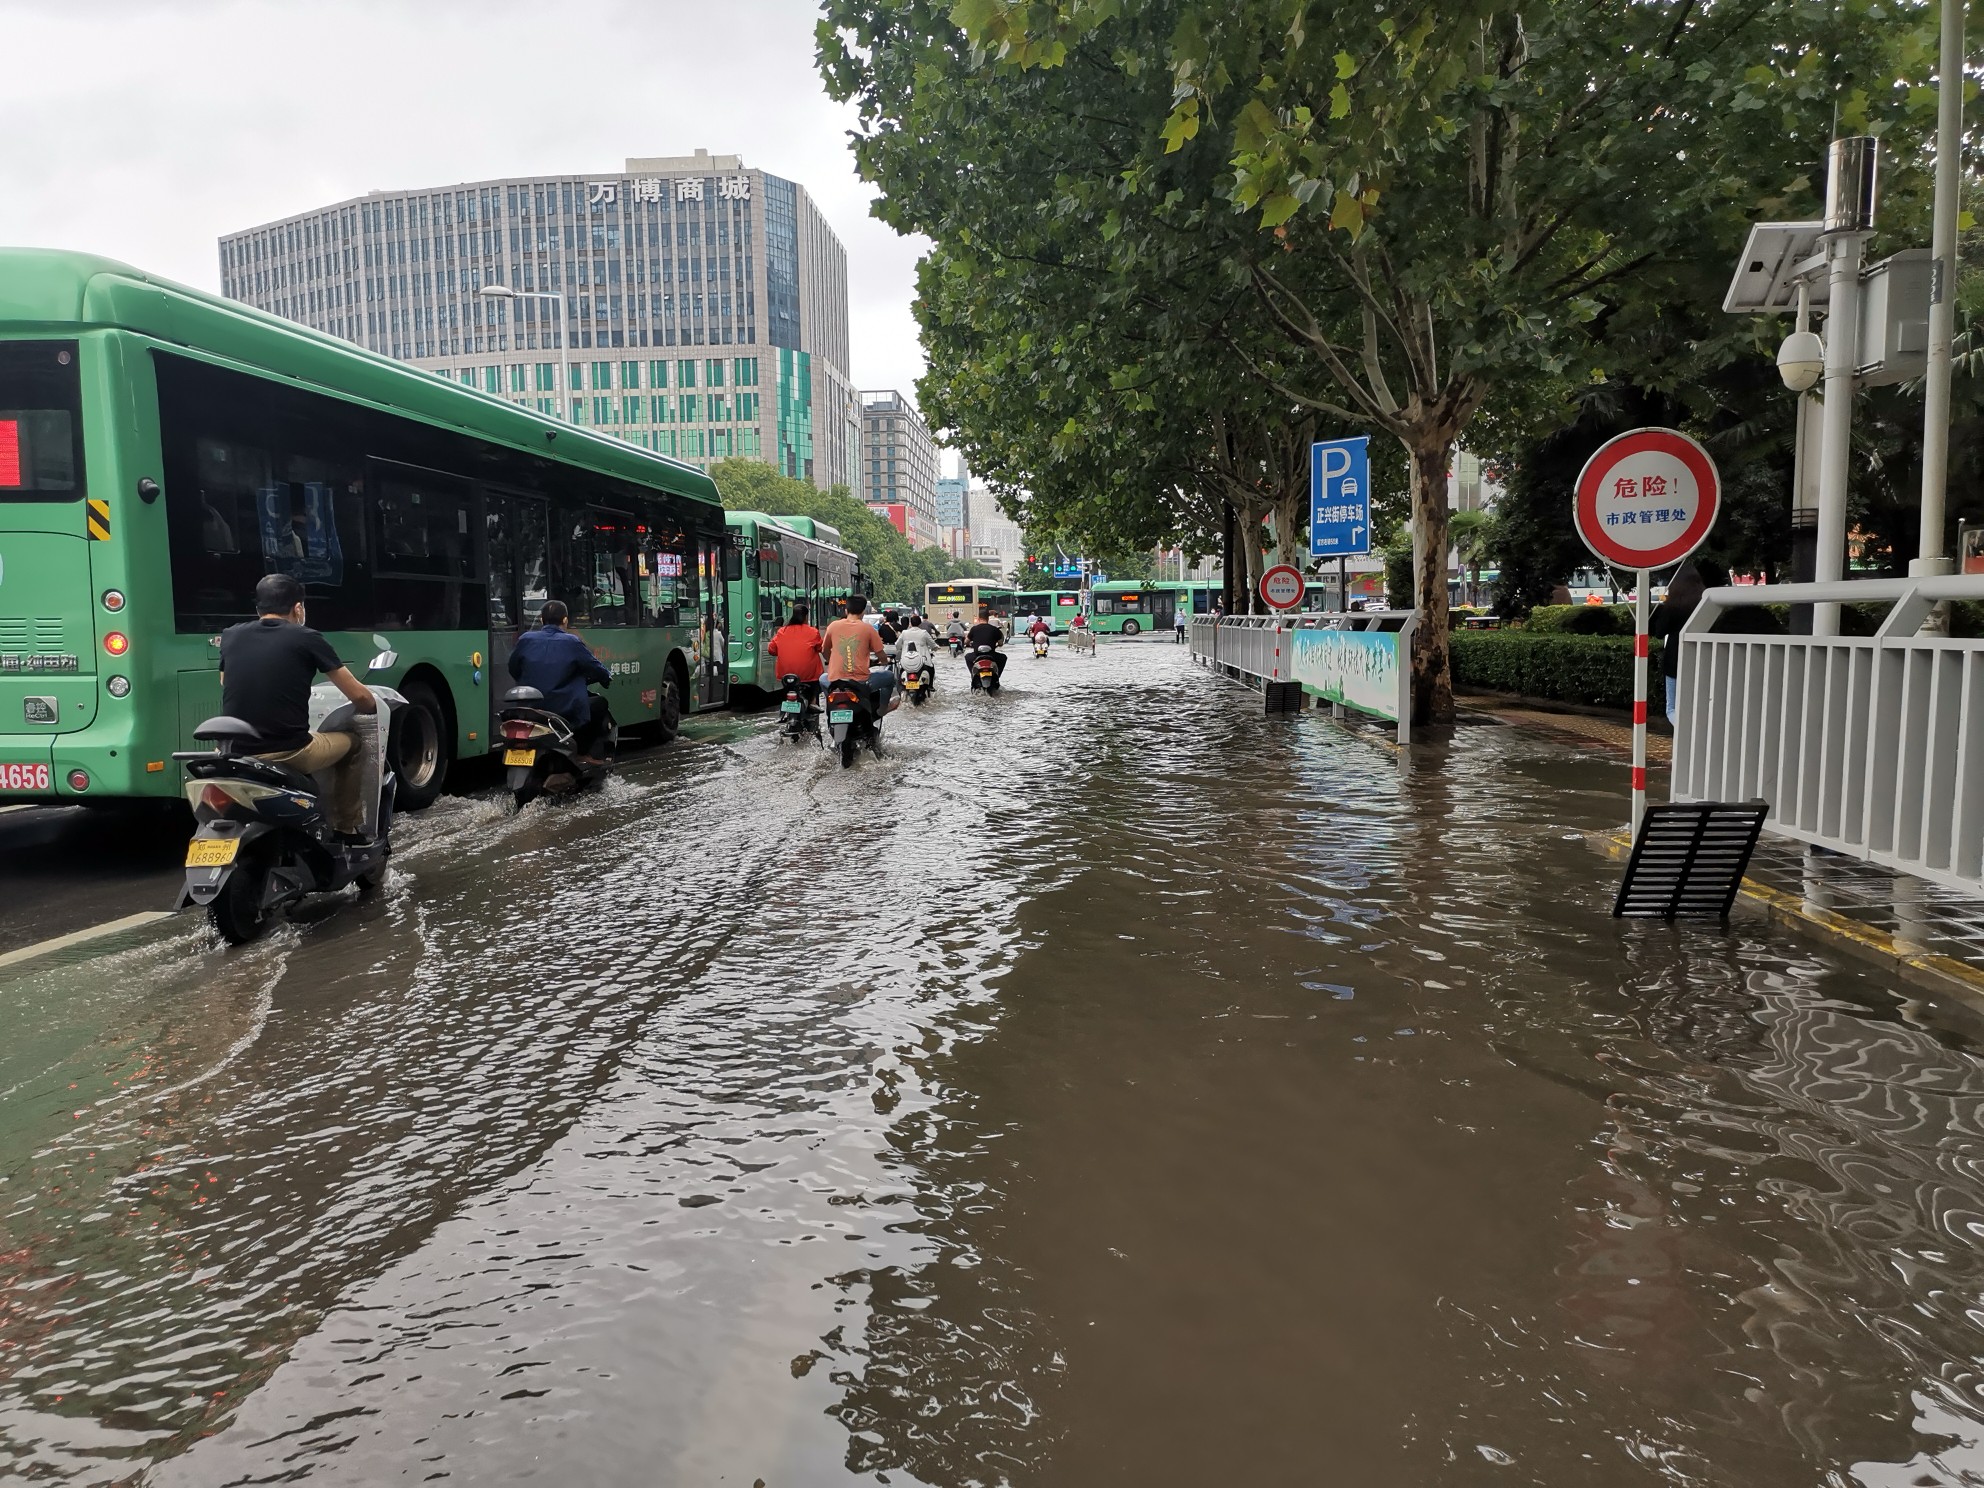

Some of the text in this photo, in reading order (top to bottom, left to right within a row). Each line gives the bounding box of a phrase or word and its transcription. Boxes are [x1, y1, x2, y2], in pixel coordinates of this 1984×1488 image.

[589, 176, 751, 203] 万博商城
[1321, 447, 1352, 499] P
[1613, 475, 1678, 499] 危险!
[1316, 503, 1364, 524] 正兴街停车场
[1606, 508, 1686, 526] 市政管理处
[610, 661, 640, 676] 纯电动
[0, 764, 49, 789] 4656
[190, 852, 233, 864] 1688960
